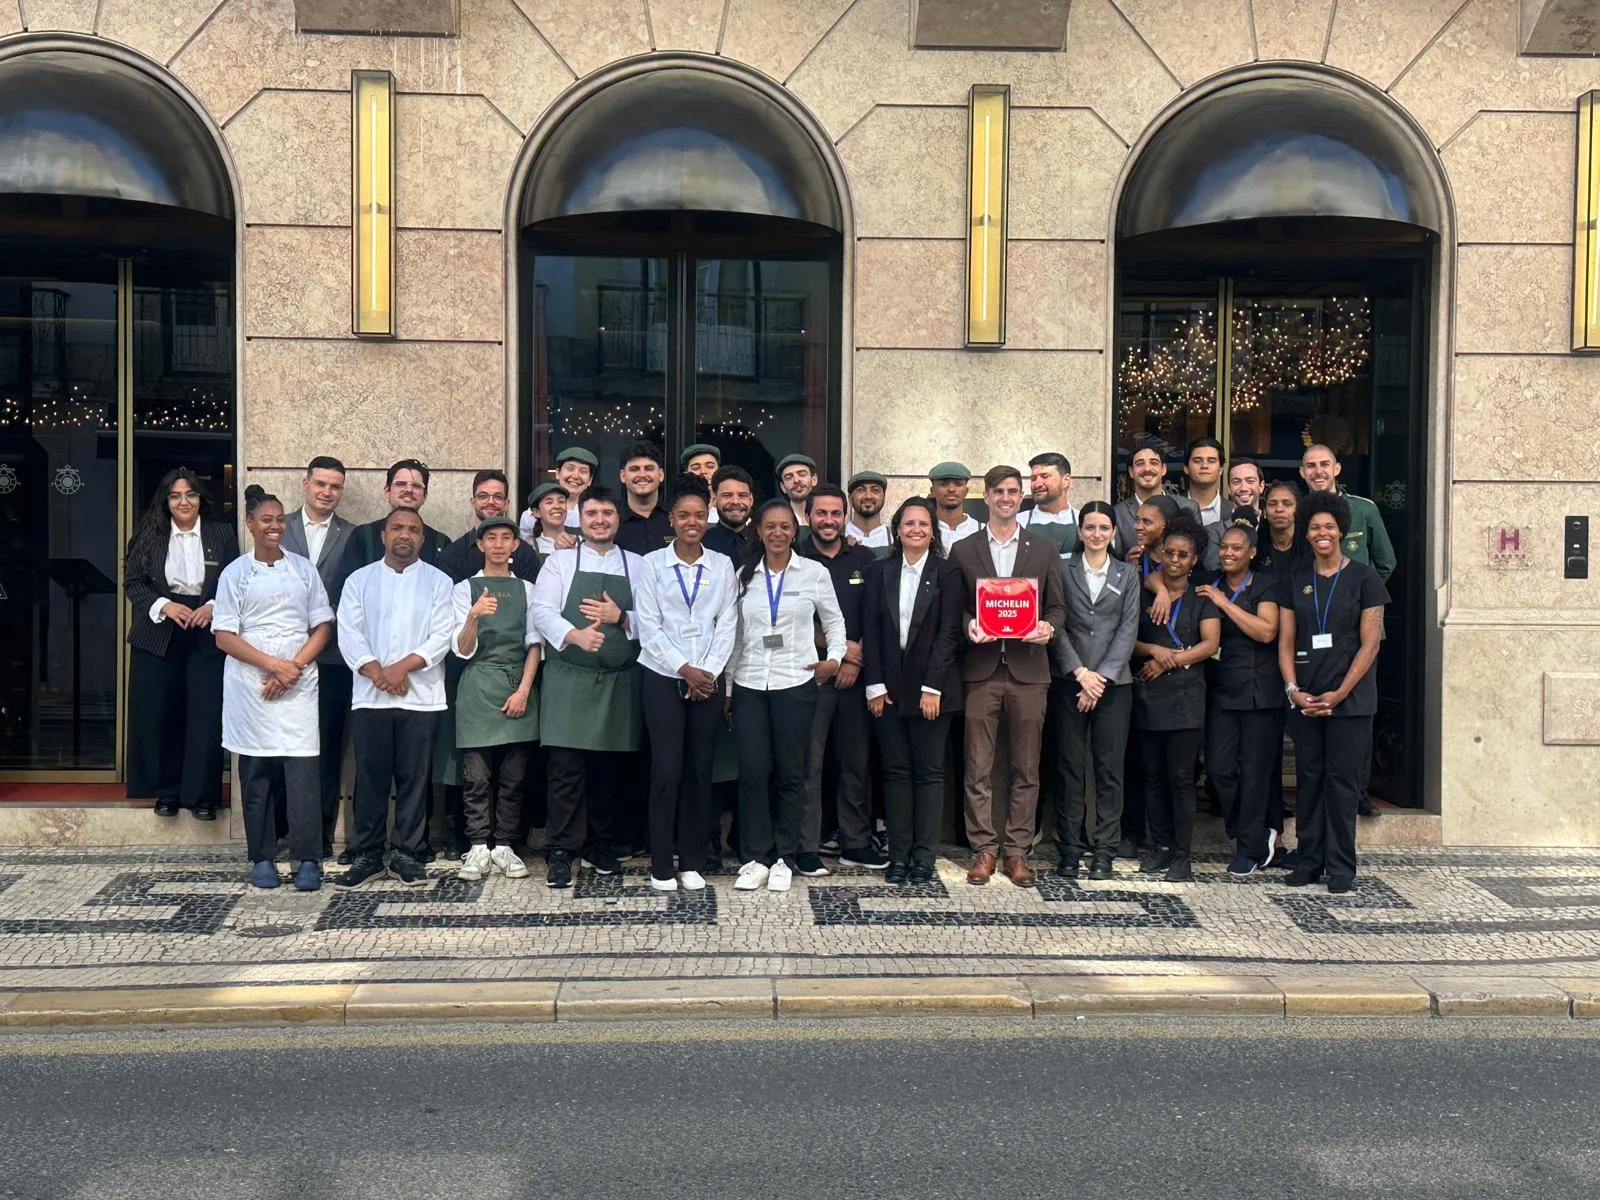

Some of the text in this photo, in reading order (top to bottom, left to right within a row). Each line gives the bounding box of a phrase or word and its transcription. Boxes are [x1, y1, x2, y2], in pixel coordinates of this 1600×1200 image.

[1500, 528, 1520, 550] H
[985, 599, 1030, 608] MICHELIN
[997, 610, 1018, 618] 2025
